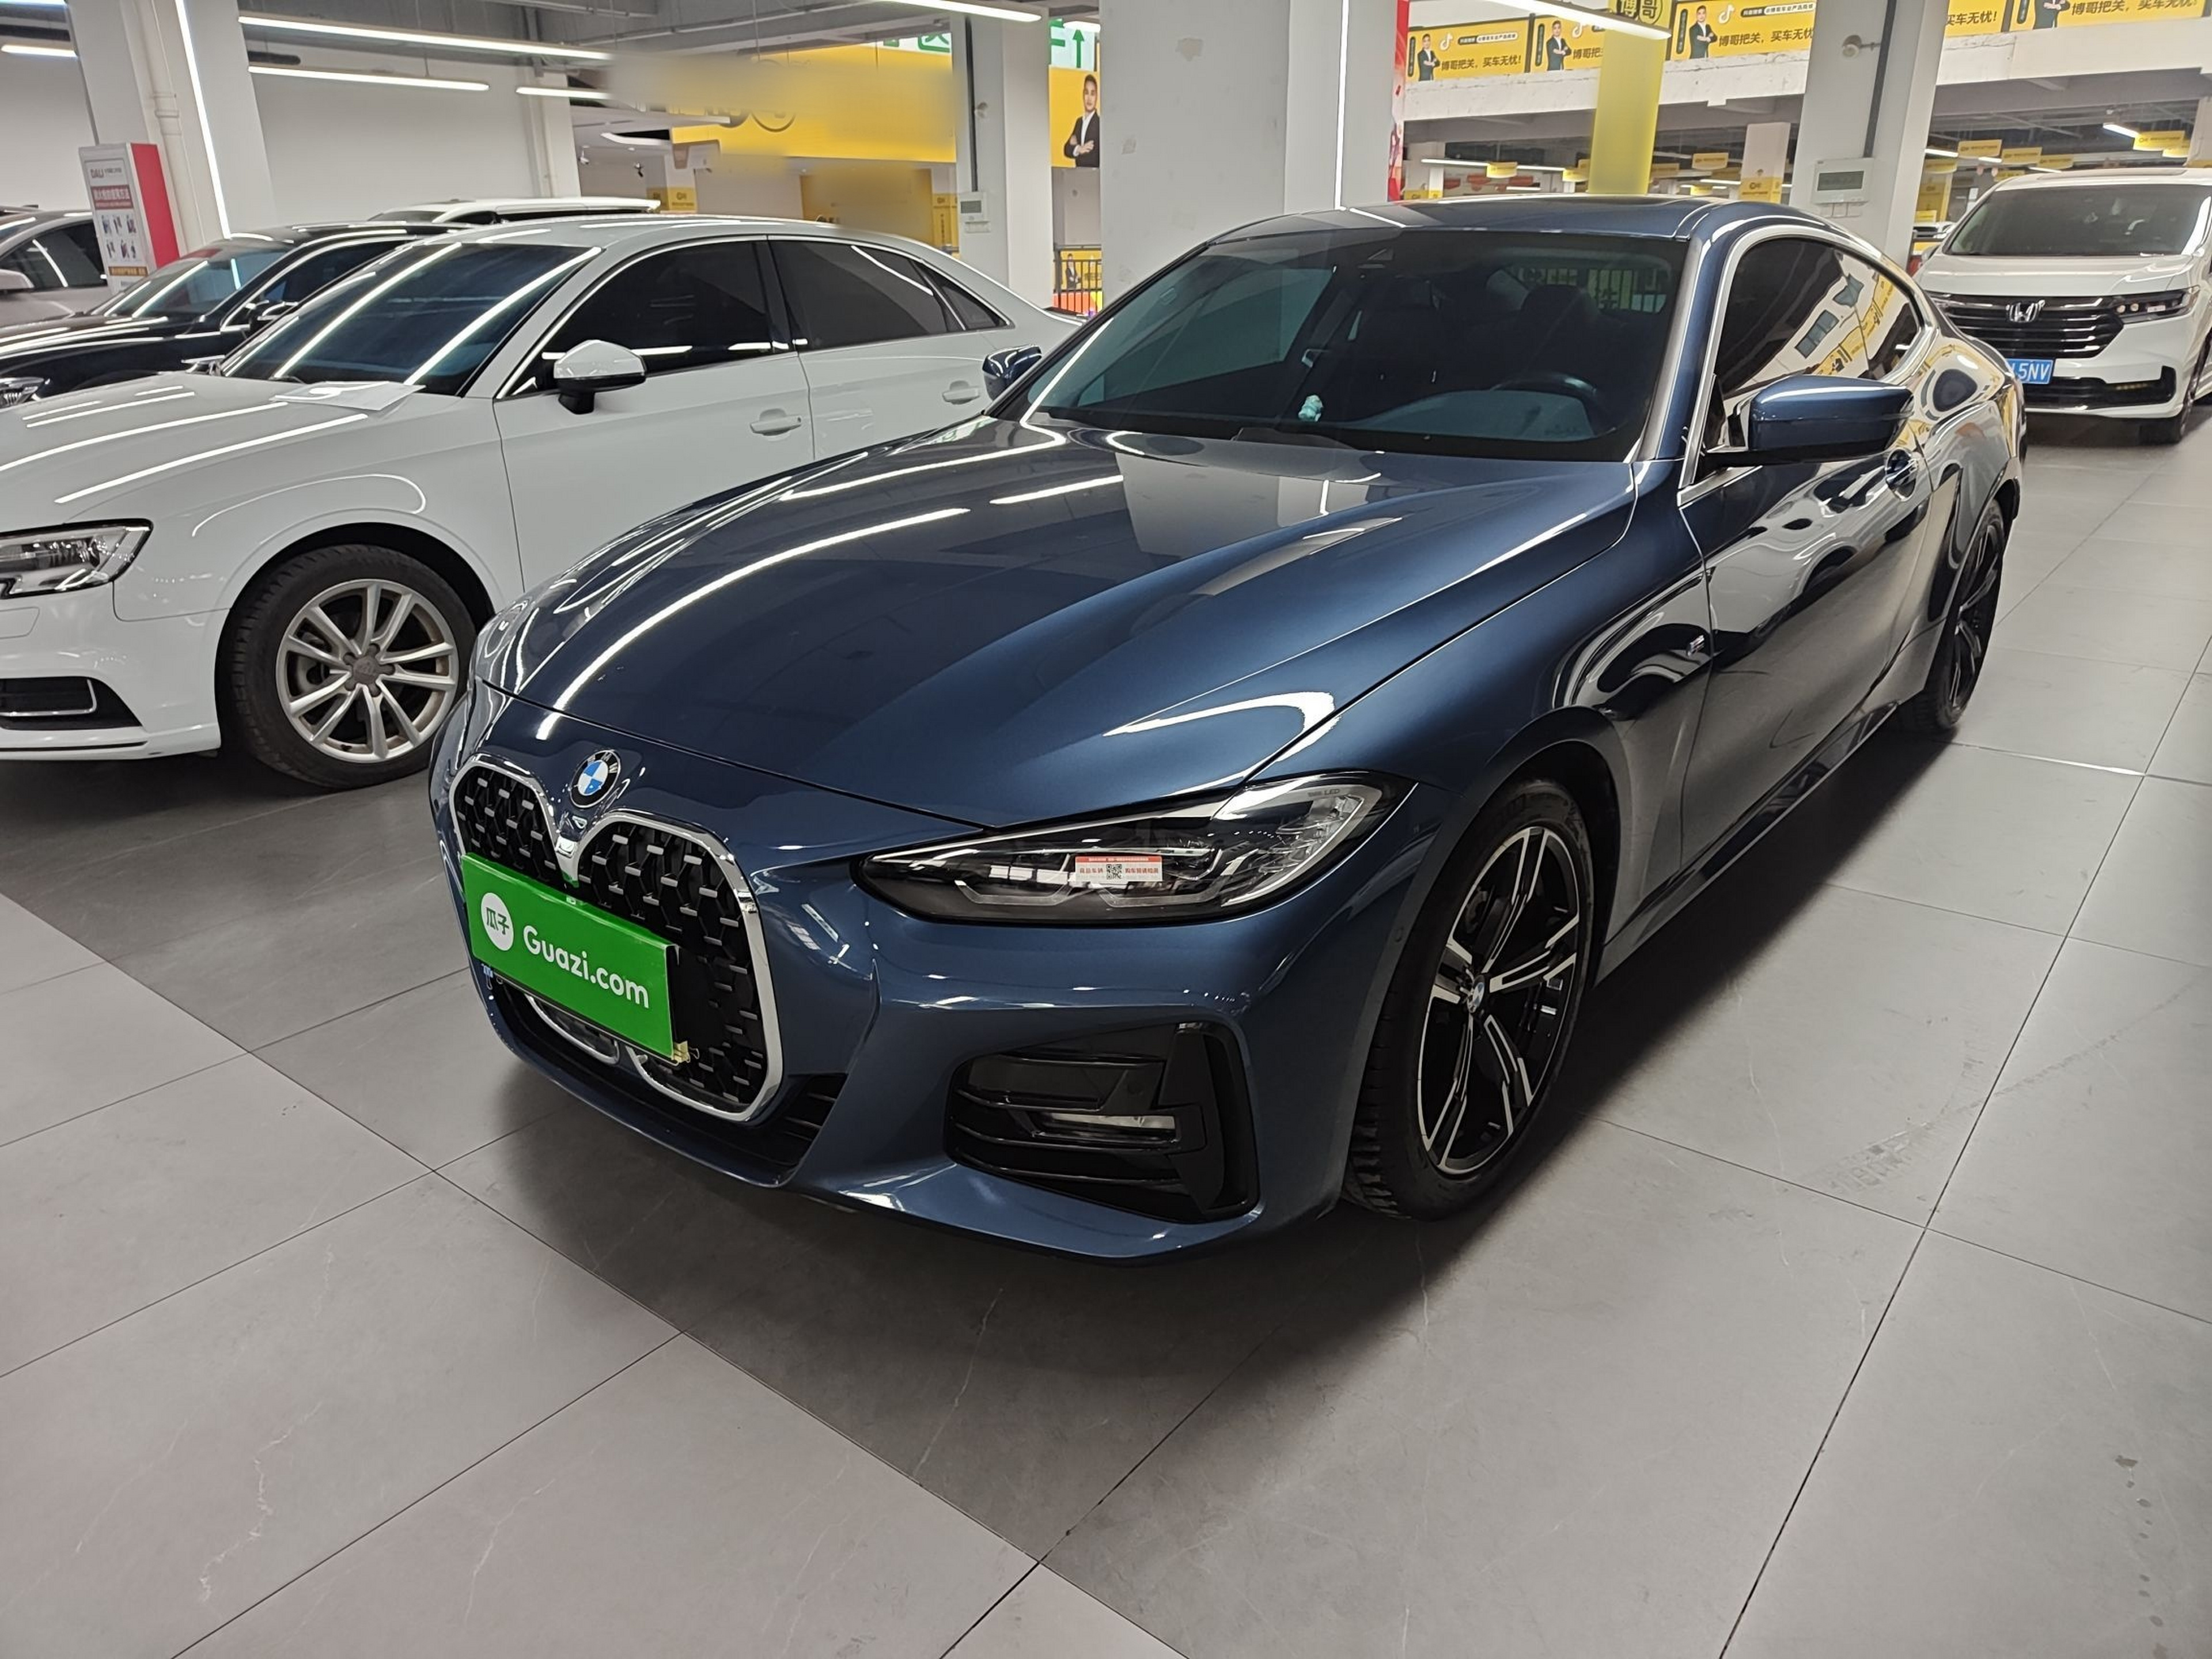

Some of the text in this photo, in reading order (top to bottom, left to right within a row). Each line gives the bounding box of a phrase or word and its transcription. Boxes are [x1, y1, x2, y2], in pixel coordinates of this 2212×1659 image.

[1573, 47, 1603, 59] 博哥把
[486, 907, 509, 935] 瓜子
[523, 925, 649, 1009] Guazi.com
